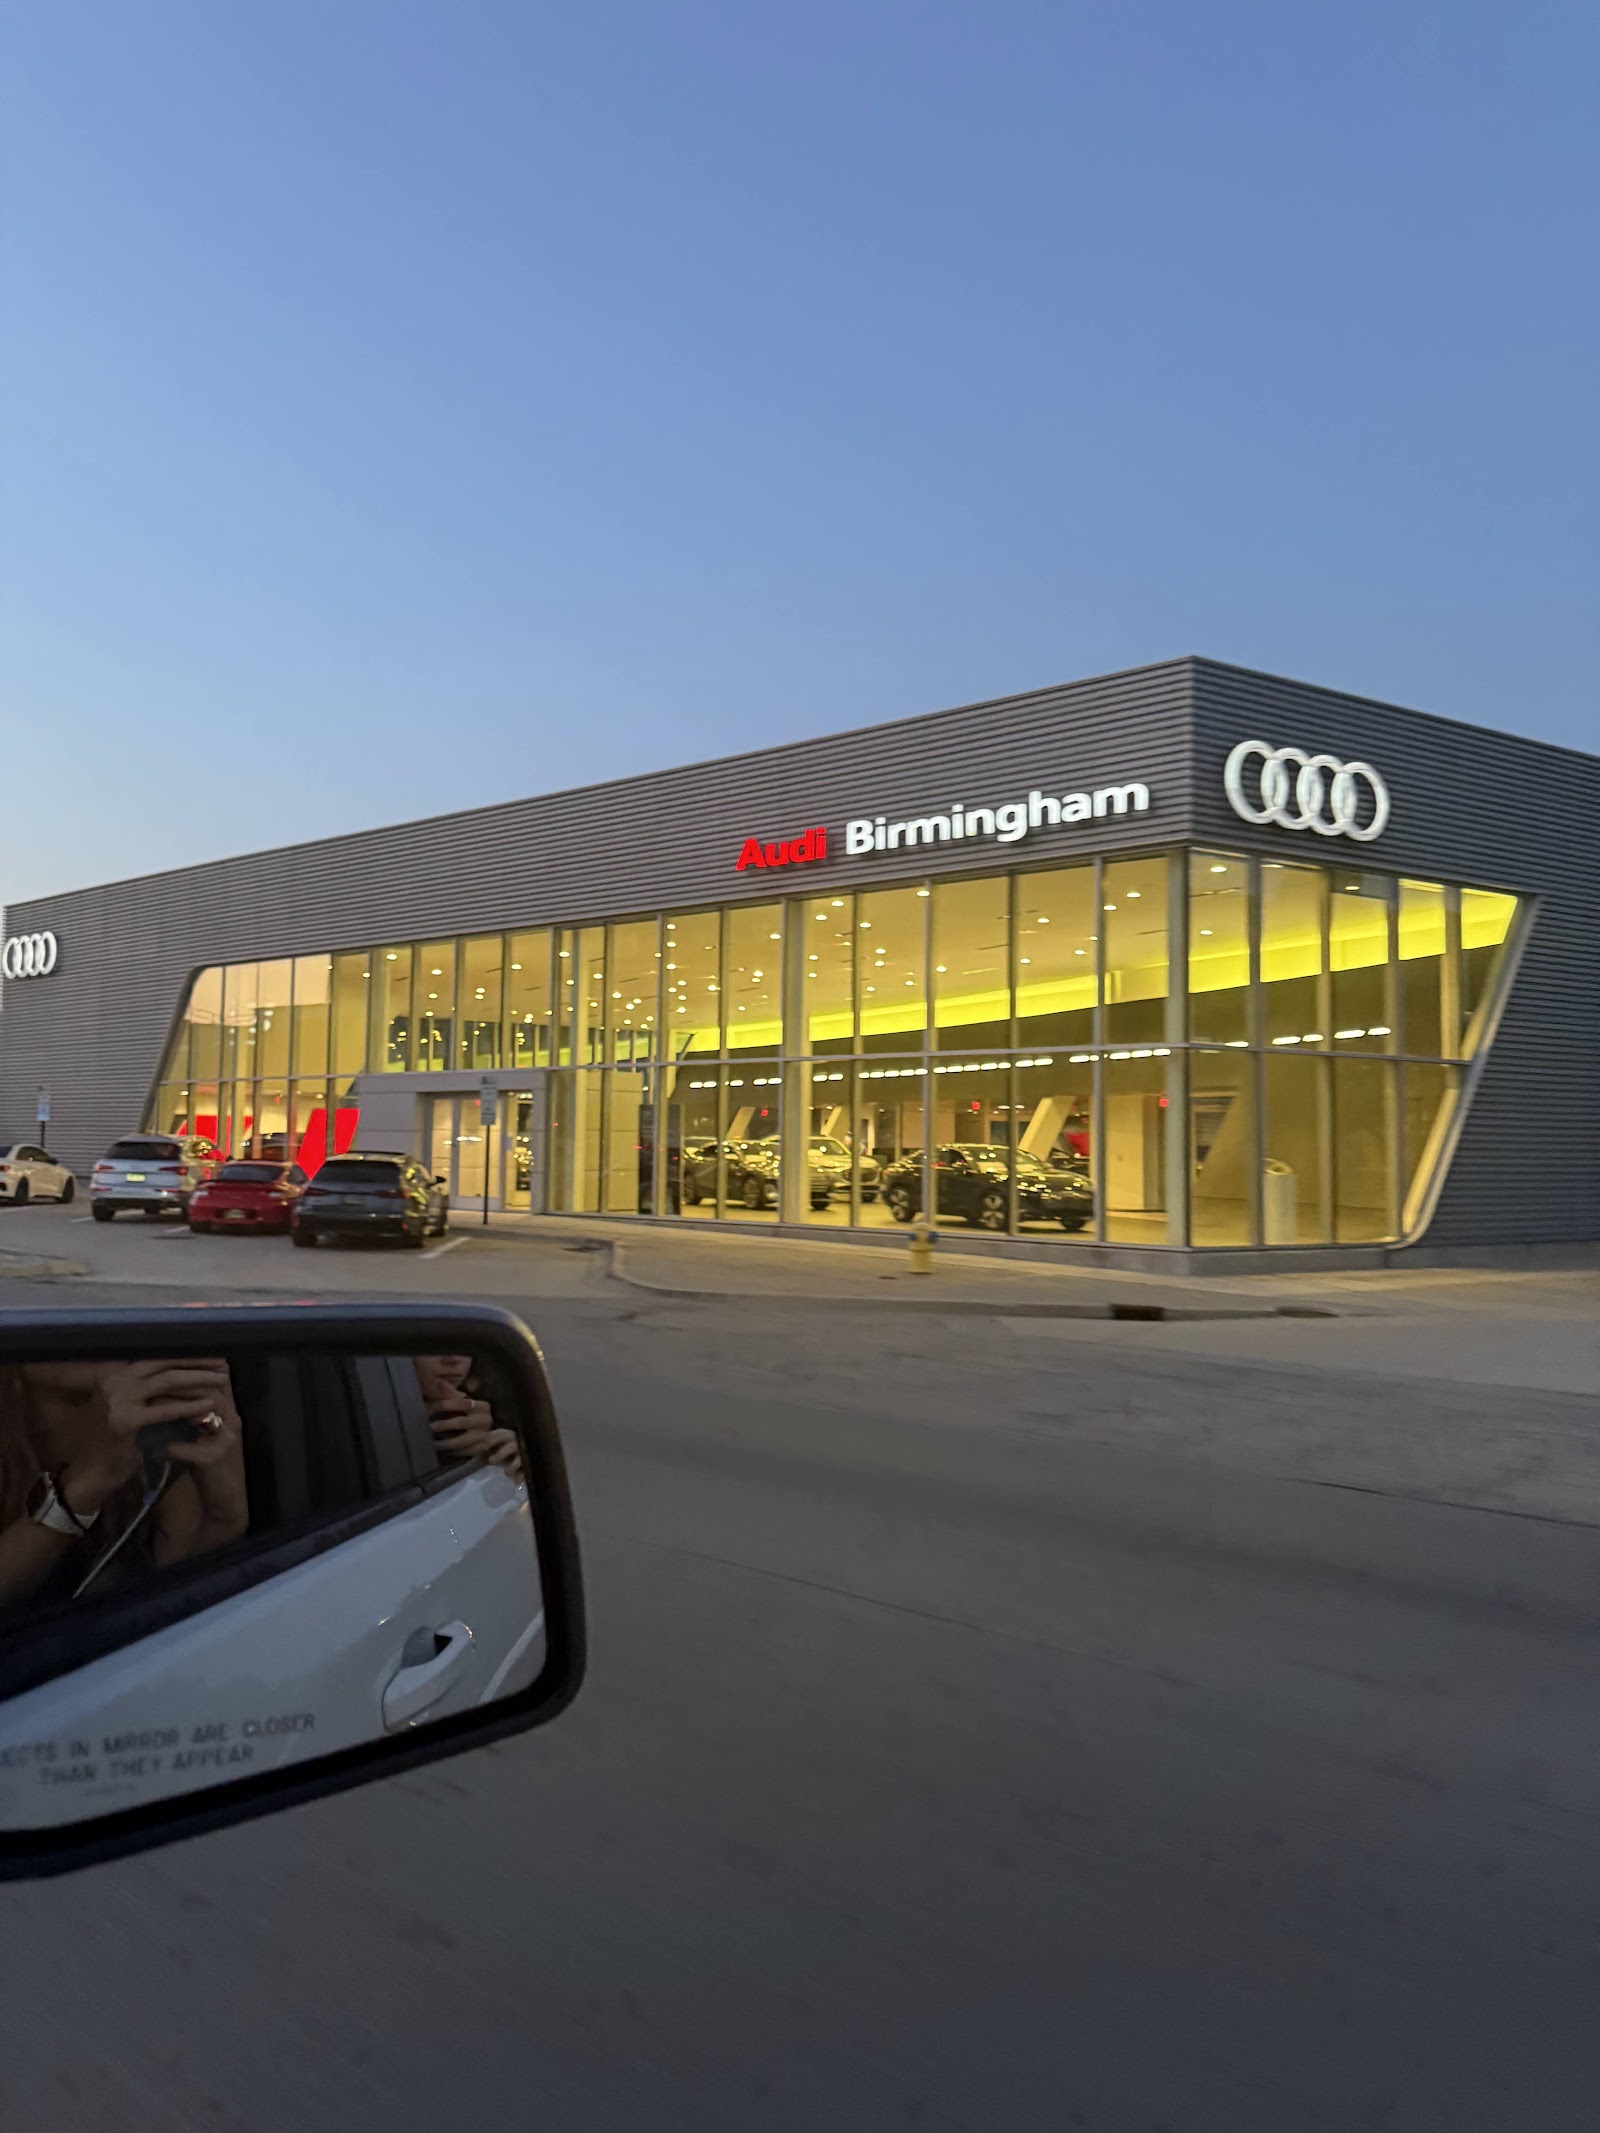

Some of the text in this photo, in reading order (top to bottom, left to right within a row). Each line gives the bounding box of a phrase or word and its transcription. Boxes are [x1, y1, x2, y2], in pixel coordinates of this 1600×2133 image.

[735, 782, 1150, 871] Audi Birmingham
[69, 1738, 89, 1758] IN
[103, 1729, 179, 1754] MIRROR
[192, 1723, 229, 1743] ARE
[241, 1713, 316, 1738] CLOSER
[40, 1745, 255, 1785] THAN THEY APPEAR
